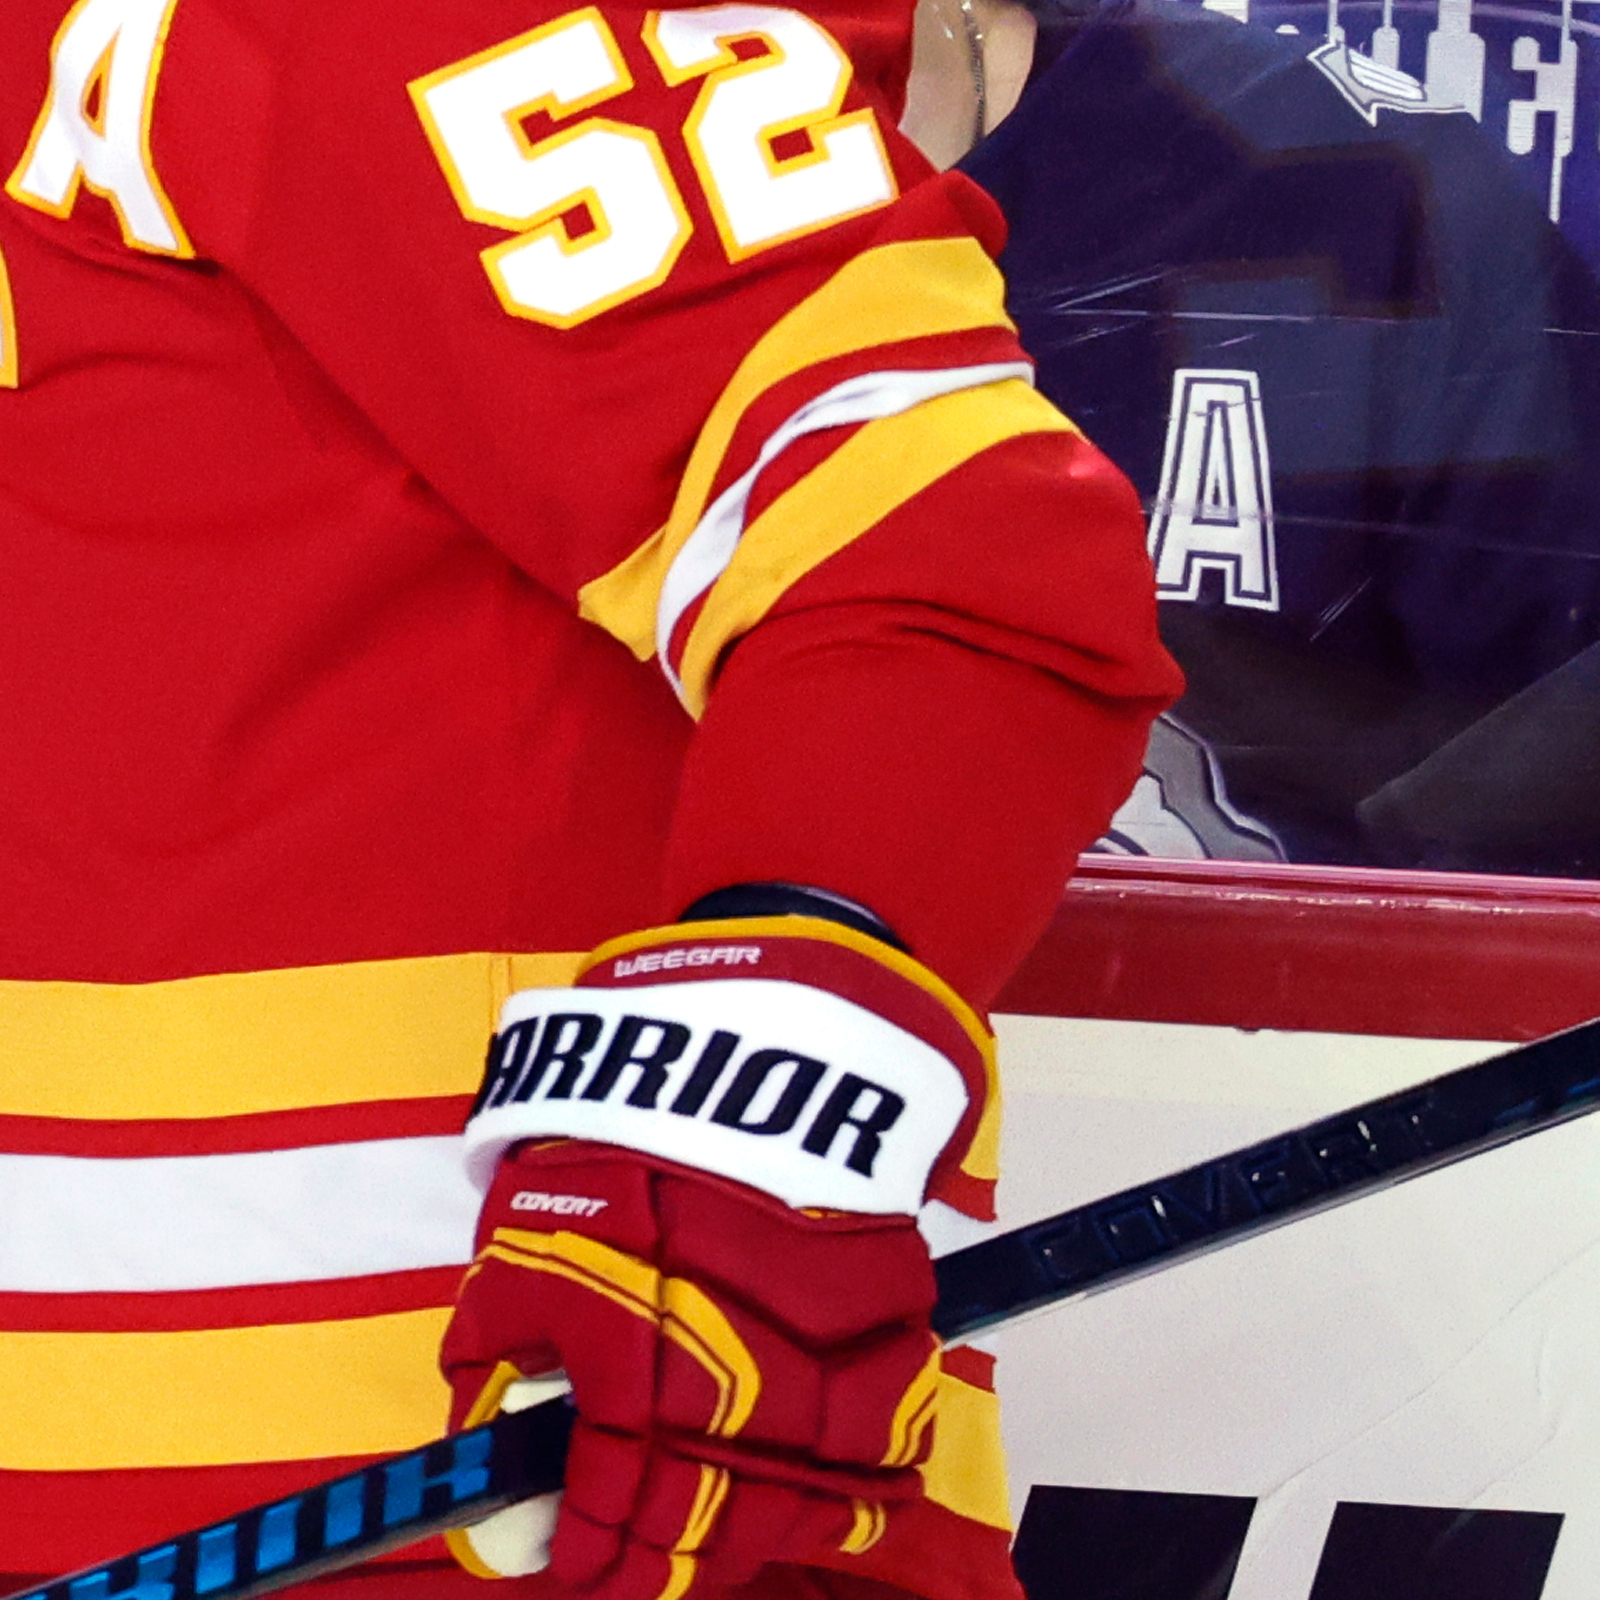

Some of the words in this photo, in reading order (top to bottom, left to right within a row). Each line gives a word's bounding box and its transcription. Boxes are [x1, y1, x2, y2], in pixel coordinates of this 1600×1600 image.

[408, 3, 901, 330] 52
[1147, 369, 1280, 611] A
[614, 945, 763, 979] WEEGAR
[464, 1012, 907, 1179] ARRIOR
[510, 1191, 609, 1218] COVERT
